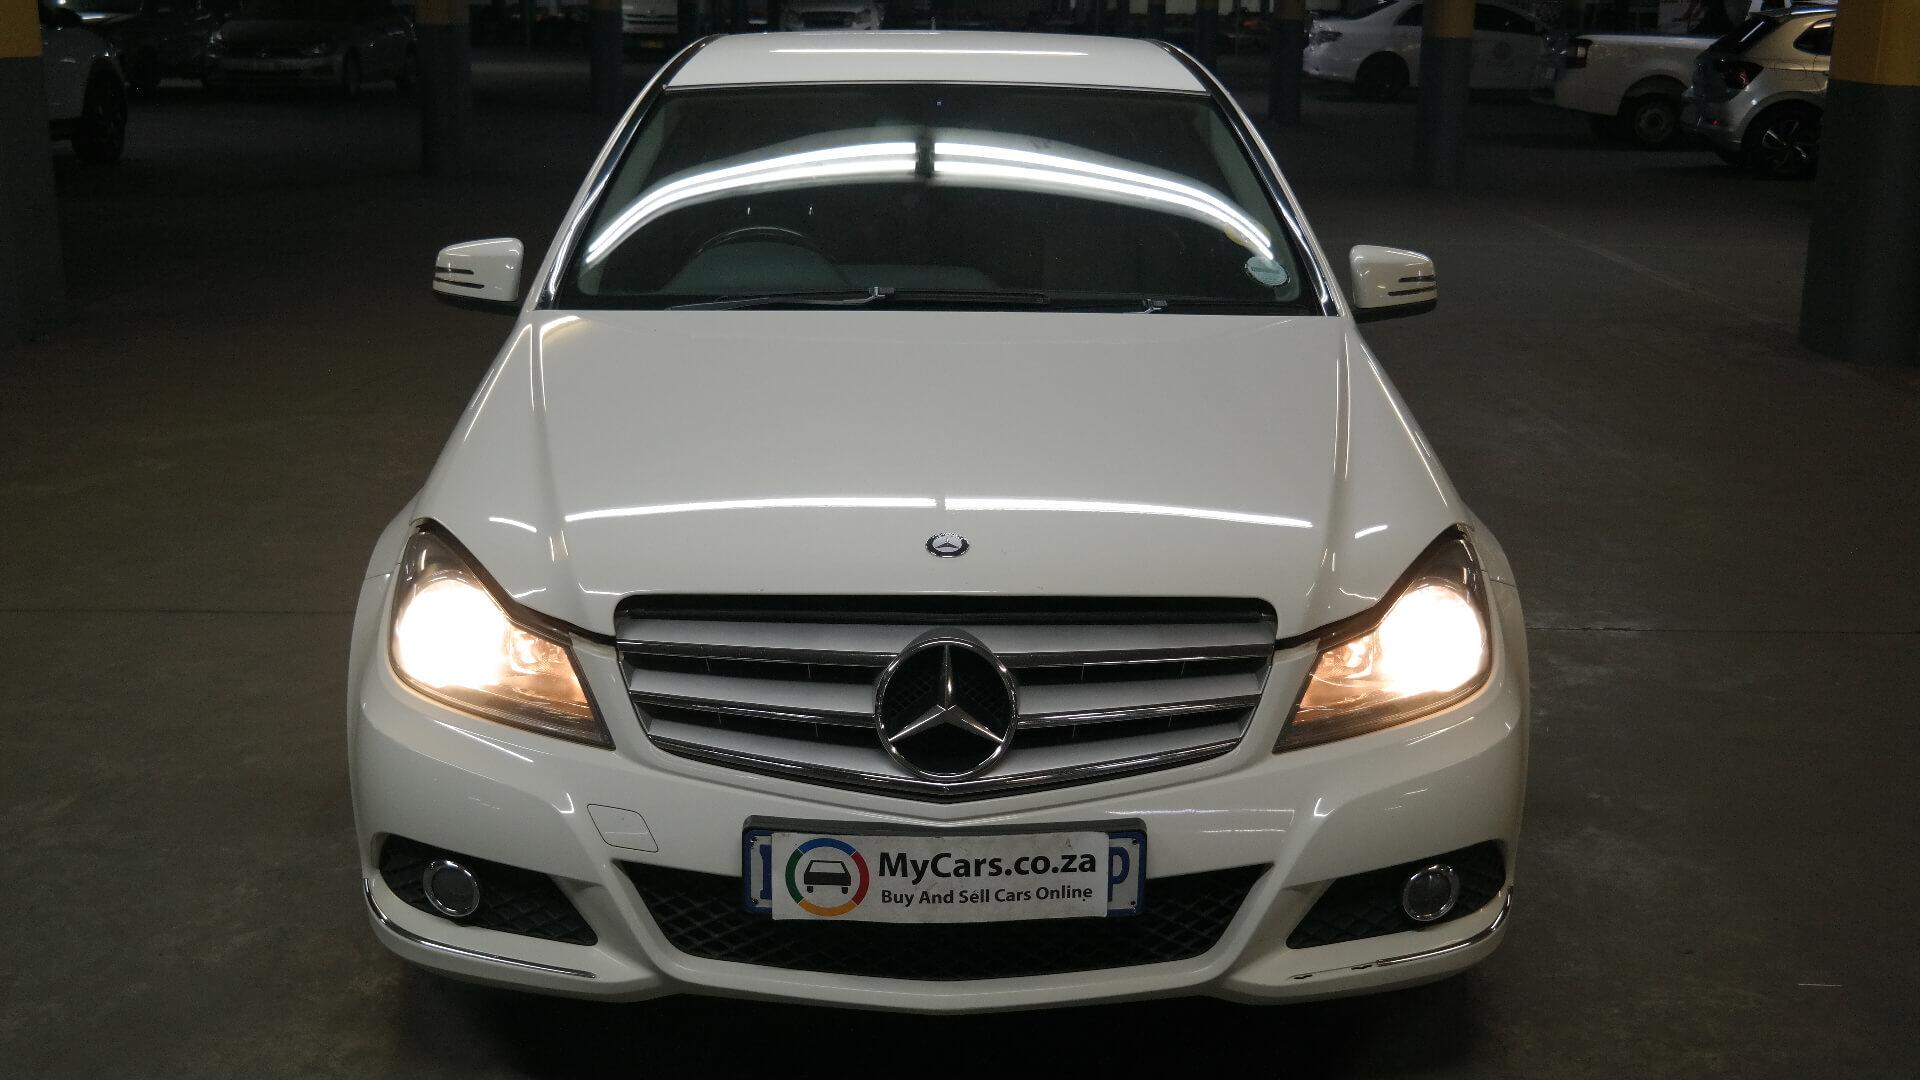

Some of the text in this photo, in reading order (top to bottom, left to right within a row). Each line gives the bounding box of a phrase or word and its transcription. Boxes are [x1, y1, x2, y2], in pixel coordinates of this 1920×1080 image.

[879, 852, 1096, 885] MyCars.co.za
[881, 885, 1093, 907] Buy And Sell Cars Online
